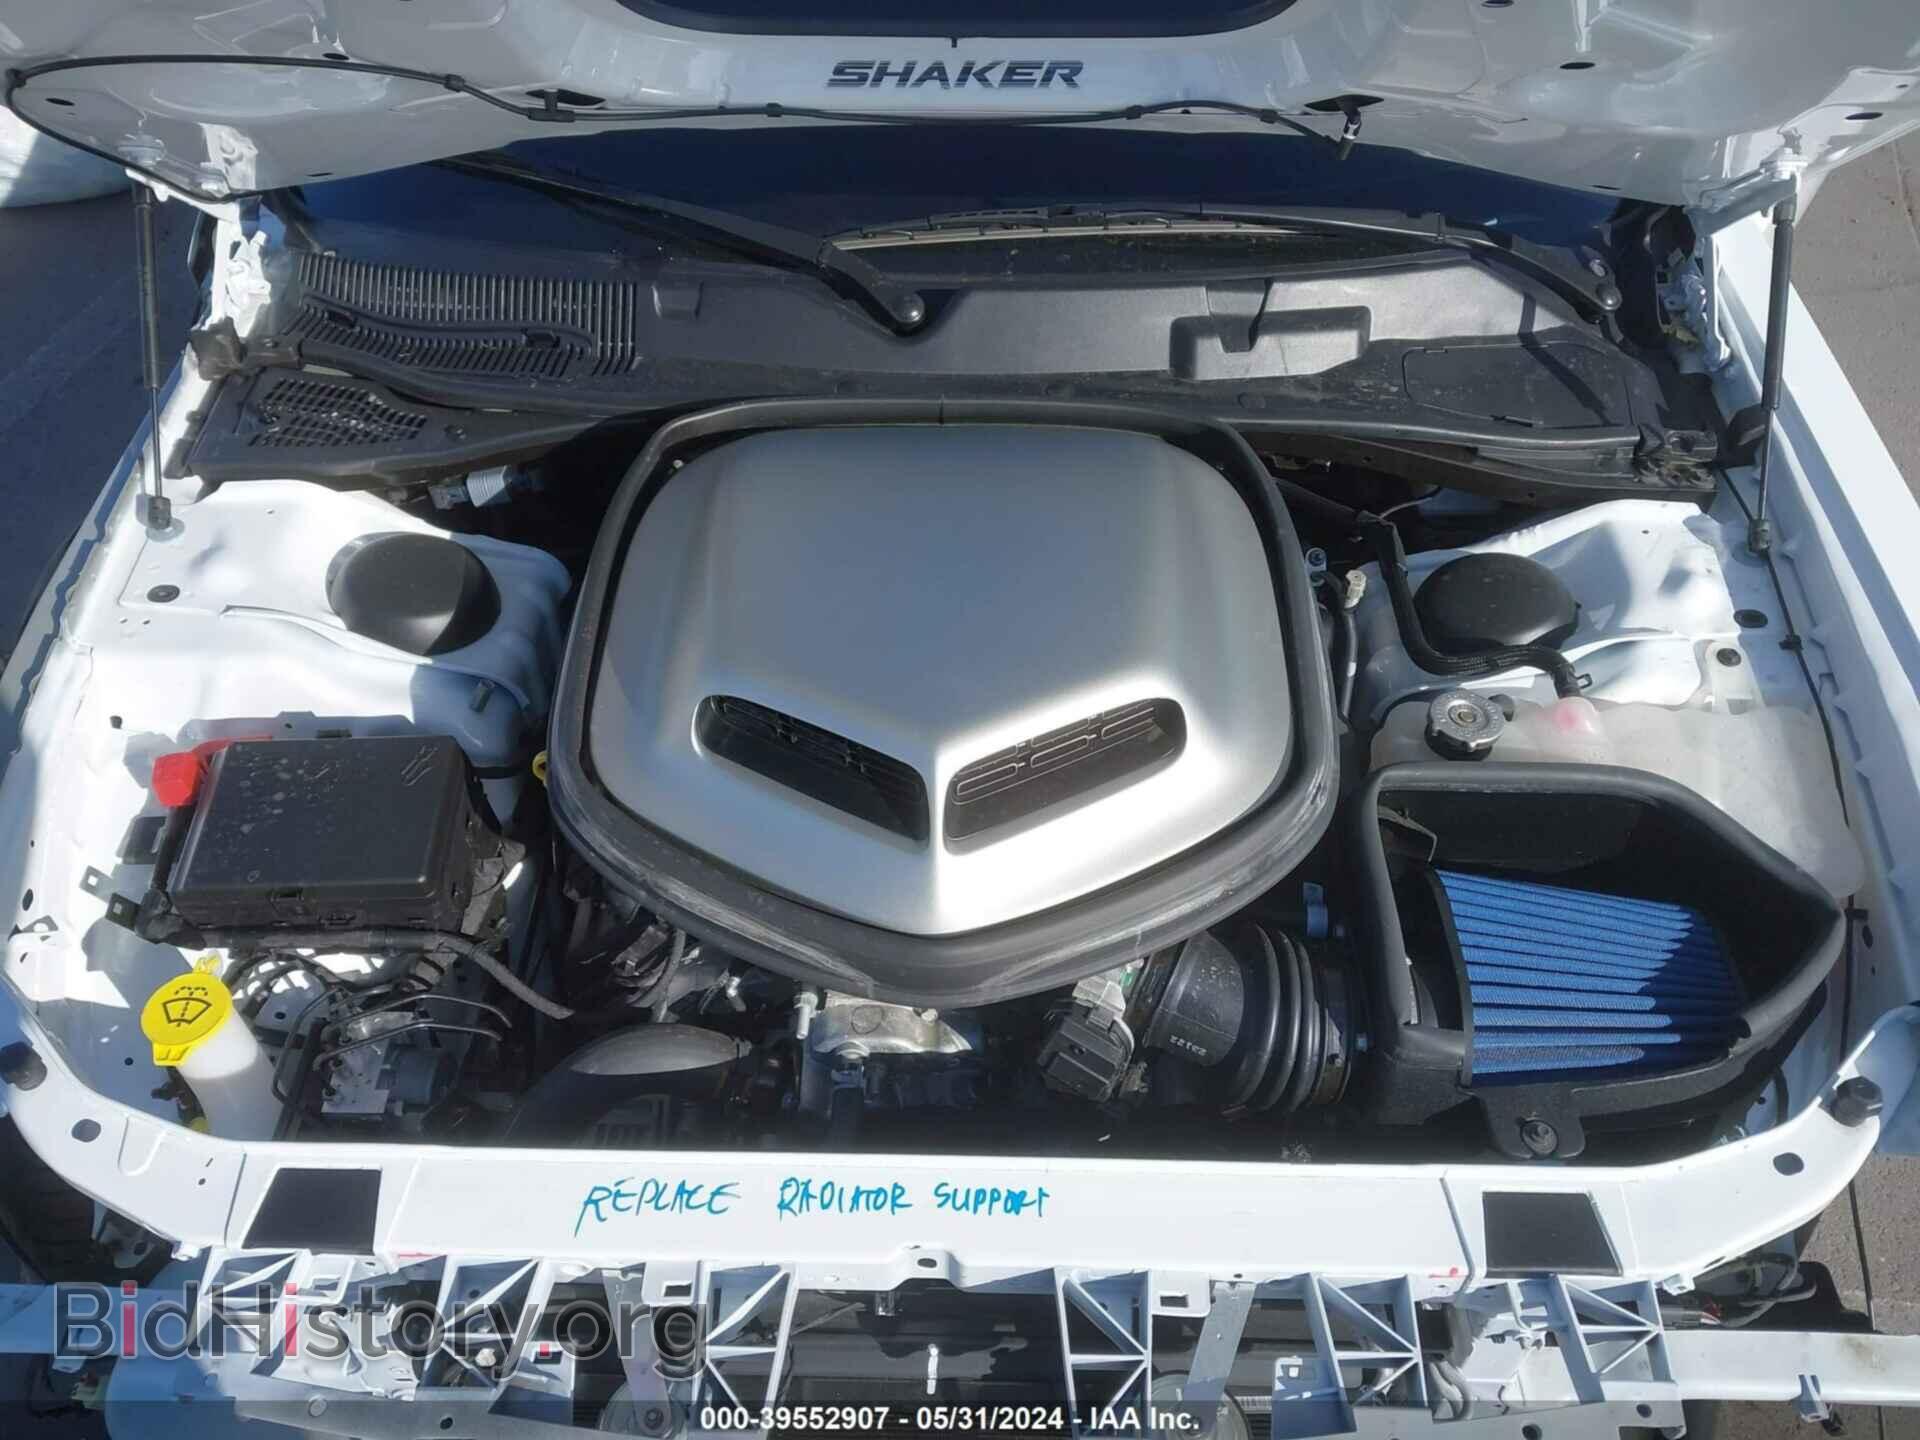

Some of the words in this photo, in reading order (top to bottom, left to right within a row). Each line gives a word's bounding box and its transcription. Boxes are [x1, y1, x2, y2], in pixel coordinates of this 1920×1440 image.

[827, 60, 1085, 89] SHAKER
[574, 1176, 742, 1238] REPLACE
[777, 1177, 913, 1221] RADIATOR
[933, 1182, 1051, 1217] SUPPORT
